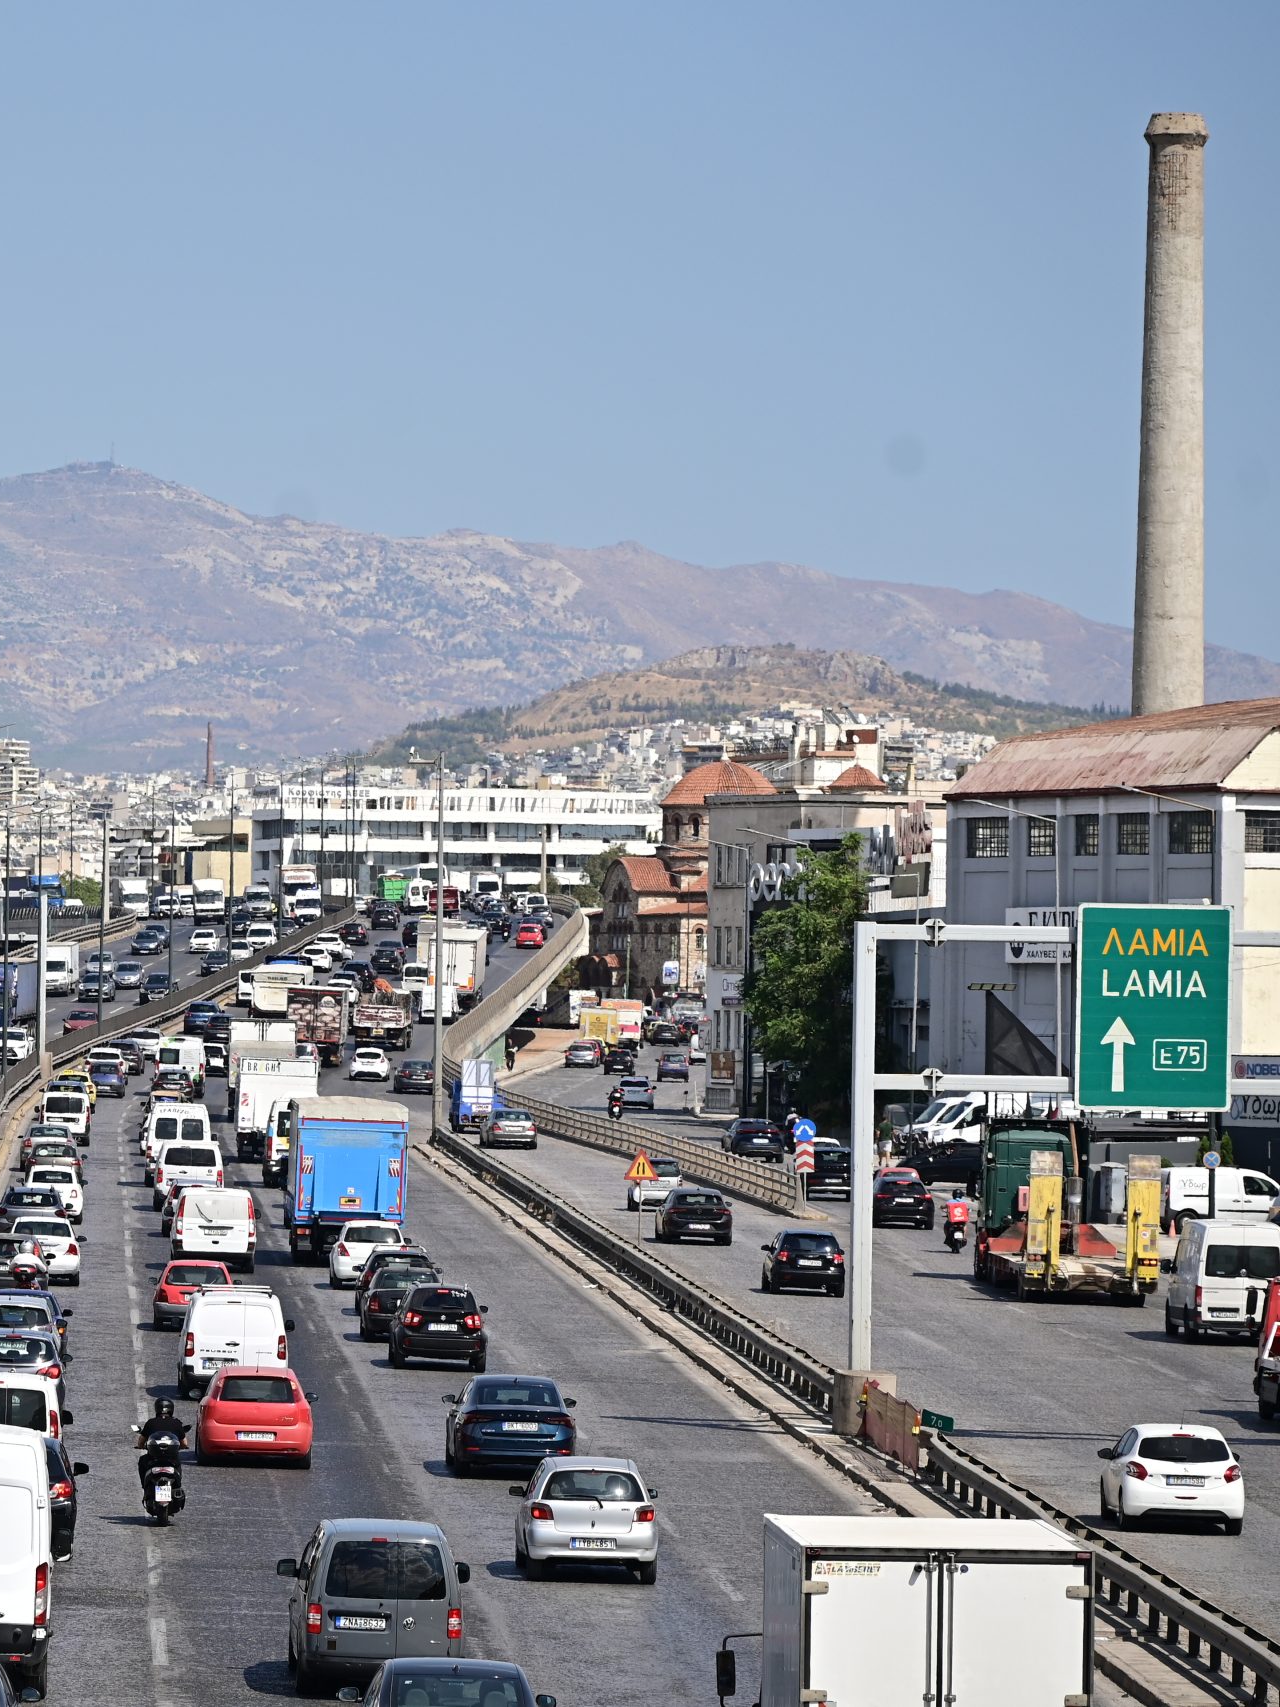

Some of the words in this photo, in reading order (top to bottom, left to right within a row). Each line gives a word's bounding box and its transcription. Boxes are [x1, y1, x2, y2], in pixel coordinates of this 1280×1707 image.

[1102, 928, 1209, 957] ΛΑΜΙΑ
[1027, 950, 1056, 959] ΧΑΛΥΒΕΣ
[1102, 969, 1207, 998] LAMIA
[1177, 1046, 1201, 1065] 75
[1246, 1063, 1280, 1076] NOBE
[931, 1415, 943, 1428] 7.0
